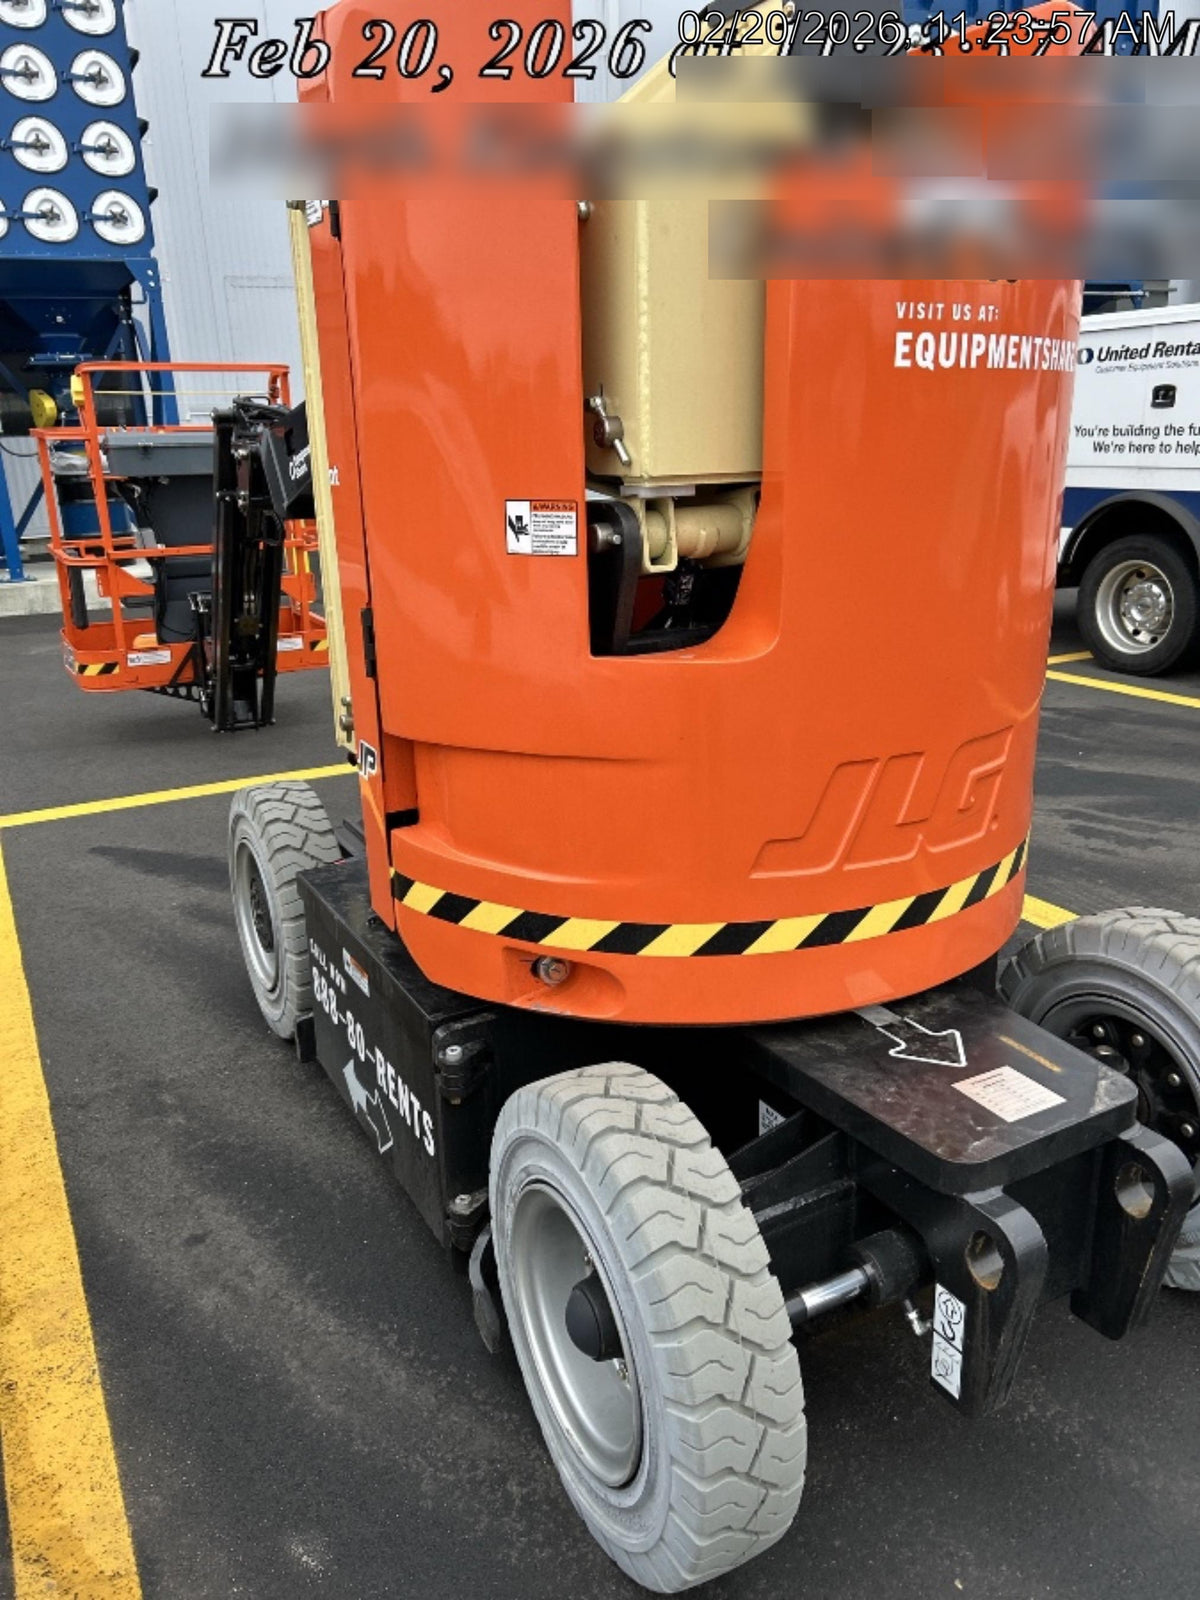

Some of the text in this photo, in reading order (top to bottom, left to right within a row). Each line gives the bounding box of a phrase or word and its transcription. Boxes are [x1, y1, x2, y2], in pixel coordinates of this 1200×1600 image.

[896, 302, 999, 322] VISIT US AT:
[1097, 342, 1151, 363] United
[1074, 425, 1109, 437] You're
[1112, 424, 1160, 440] building
[1164, 423, 1185, 436] the
[1092, 440, 1126, 454] We're
[1128, 441, 1155, 454] here
[1159, 441, 1172, 454] to
[312, 966, 435, 1157] 888-80-RENTS
